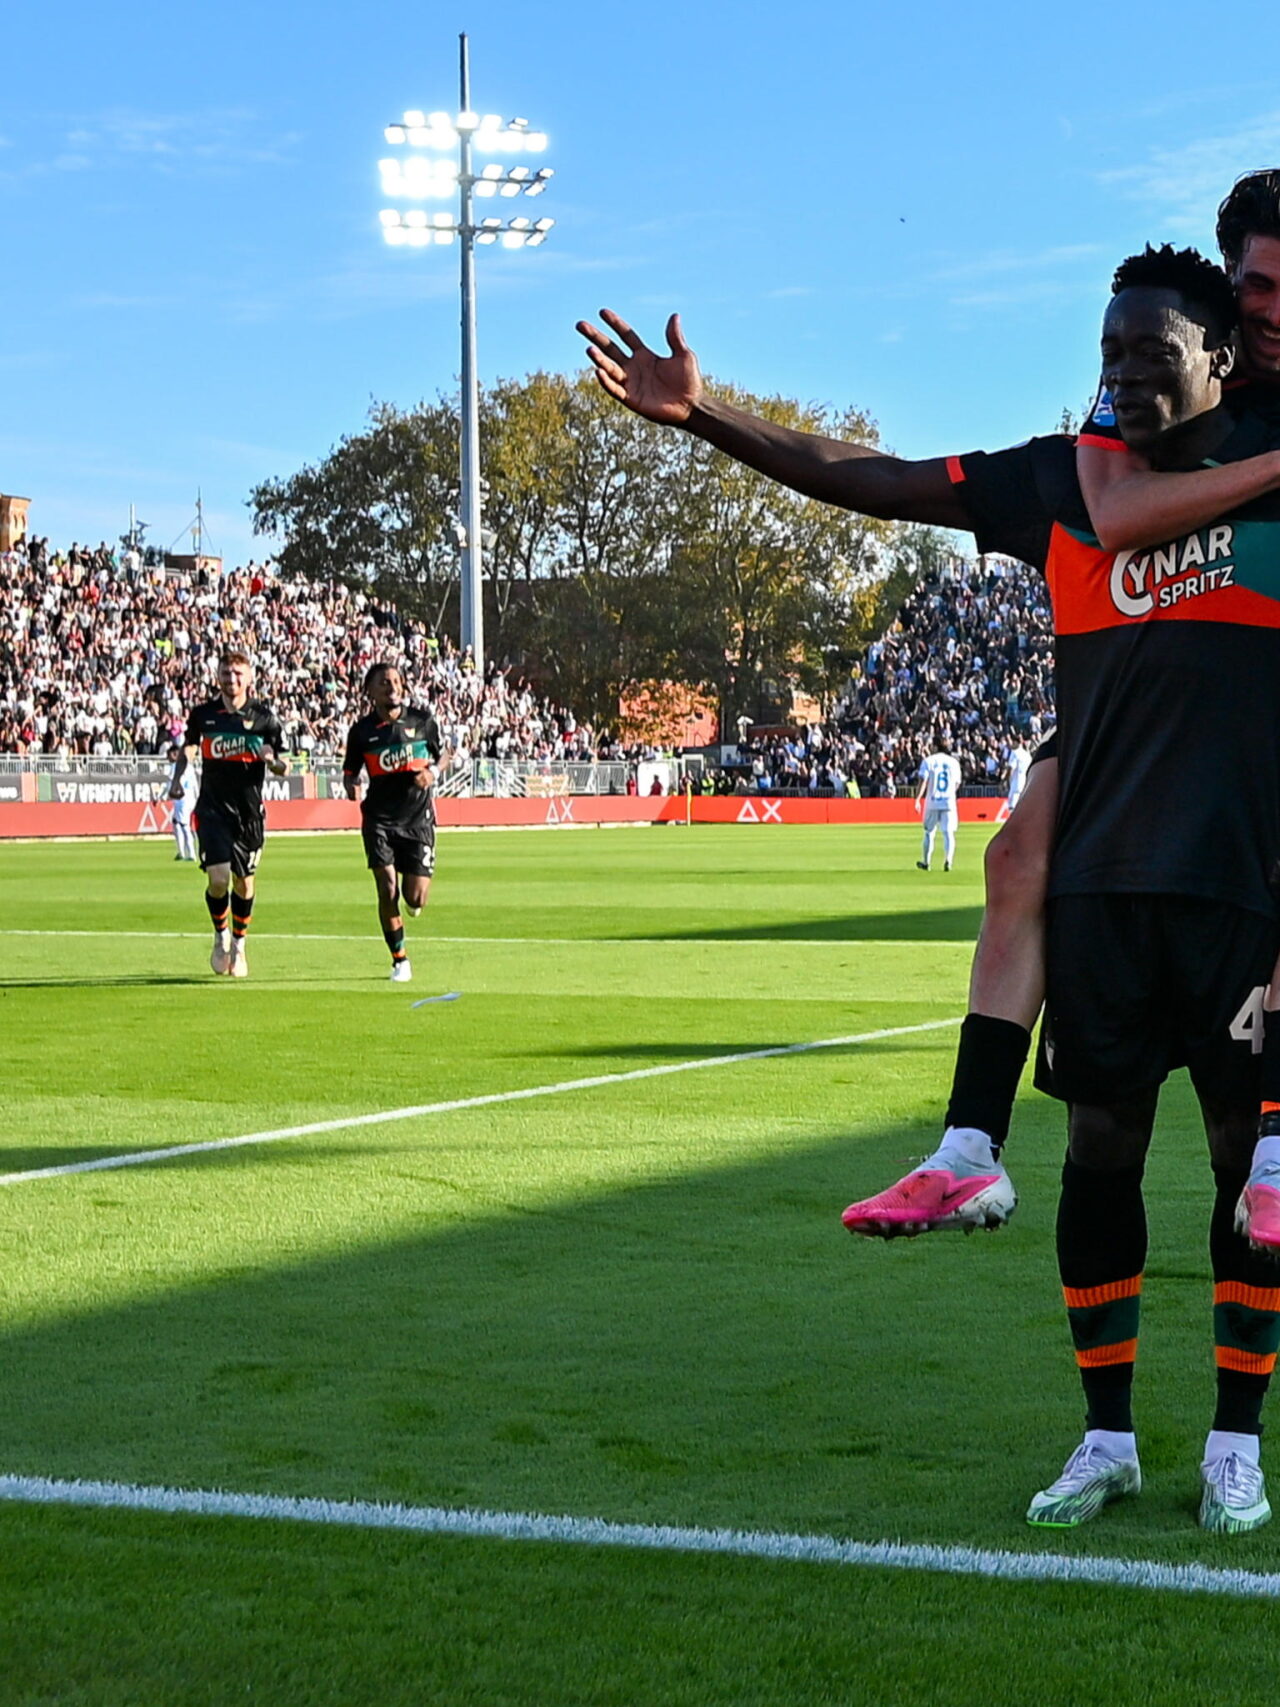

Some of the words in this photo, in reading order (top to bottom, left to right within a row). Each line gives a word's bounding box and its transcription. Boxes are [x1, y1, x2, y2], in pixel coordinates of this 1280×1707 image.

[1110, 524, 1233, 616] CYNAR
[1159, 565, 1234, 607] SPRITZ
[212, 735, 246, 758] CYNAR
[379, 744, 414, 772] CYNAR
[546, 799, 574, 823] AX
[736, 799, 783, 821] AX
[1228, 986, 1266, 1055] 4
